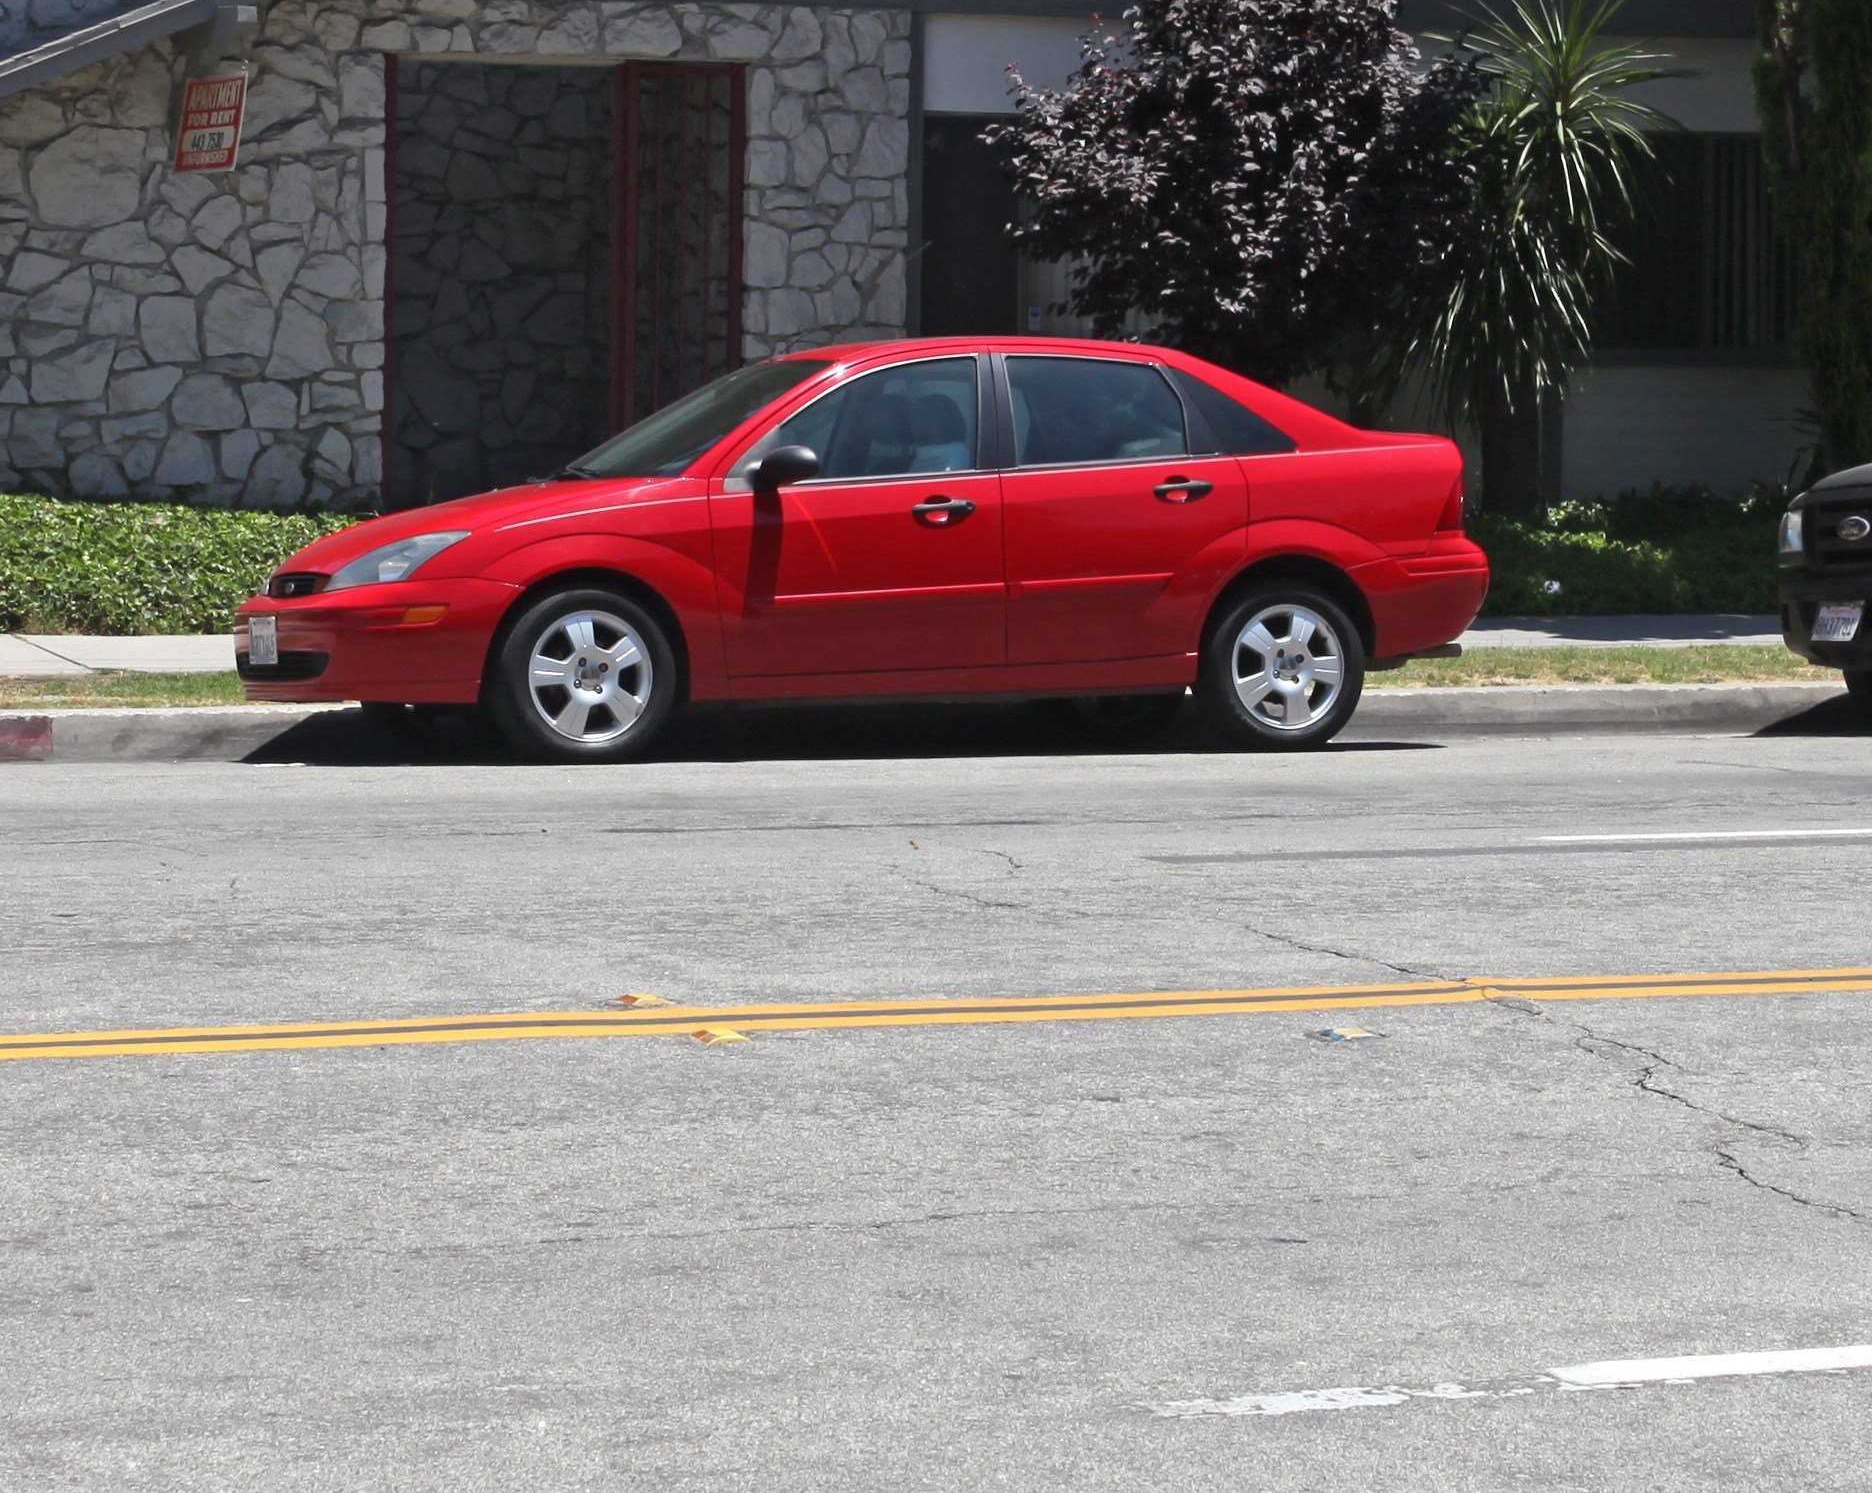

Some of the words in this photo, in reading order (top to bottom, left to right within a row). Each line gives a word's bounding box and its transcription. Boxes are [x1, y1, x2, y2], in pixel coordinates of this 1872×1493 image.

[188, 80, 242, 111] APARTMENT
[188, 112, 209, 126] FOR
[210, 109, 236, 125] RENT
